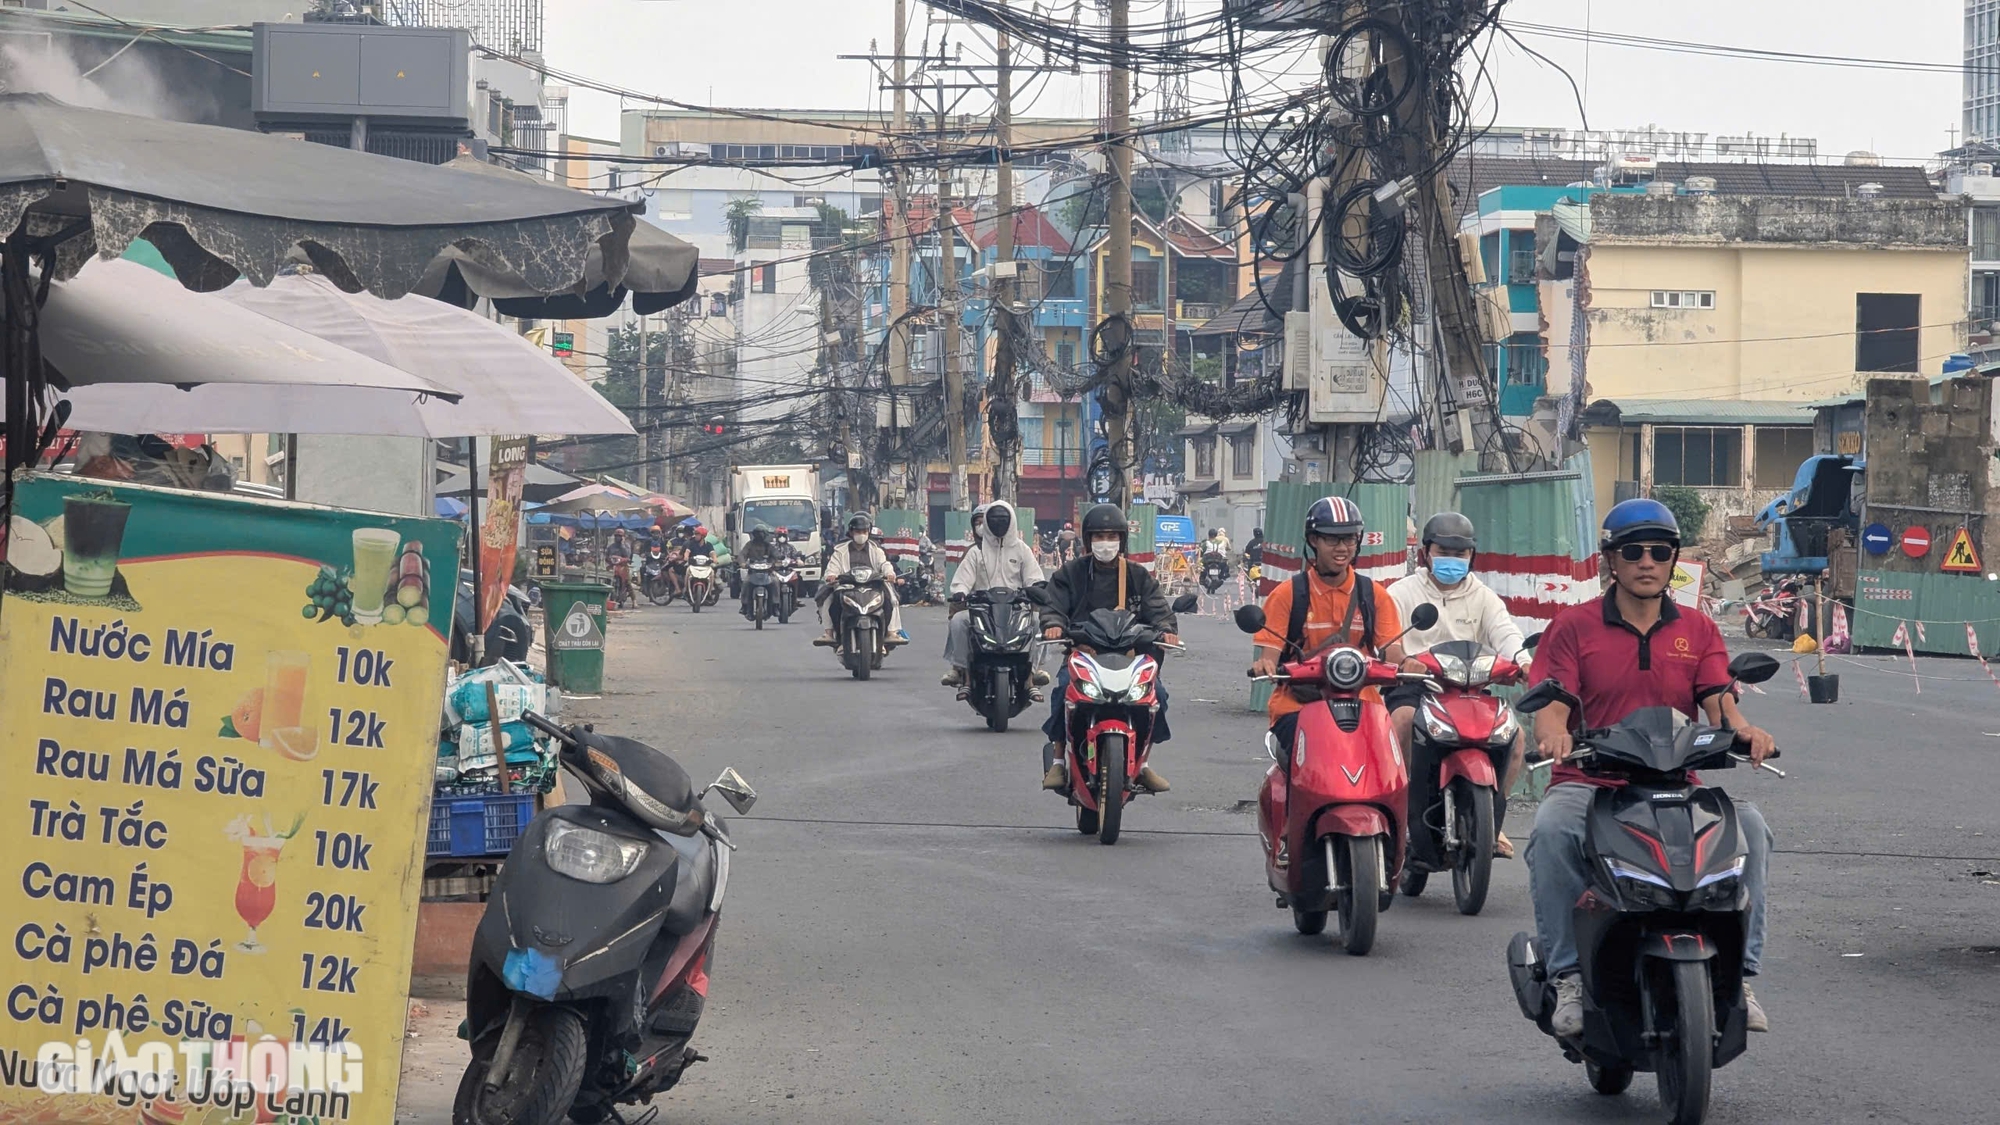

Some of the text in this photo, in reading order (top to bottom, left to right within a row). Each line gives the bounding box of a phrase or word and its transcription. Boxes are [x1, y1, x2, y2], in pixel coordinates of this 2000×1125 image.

[498, 445, 526, 464] LONG
[51, 617, 234, 670] Nước Mía
[337, 646, 393, 688] 10k
[44, 678, 189, 727] Rau Má
[329, 707, 386, 748] 12k
[37, 739, 265, 797] Rau Má Sữa
[322, 769, 379, 809] 17k
[30, 800, 166, 848] Trà Tắc
[315, 829, 372, 871] 10k
[23, 862, 172, 917] Cam Ép
[304, 892, 365, 933] 20k
[15, 923, 225, 978] Cà phê Đá
[302, 953, 359, 993] 12k
[7, 985, 233, 1041] Cà phê Sữa
[293, 1013, 350, 1055] 14k
[92, 1058, 180, 1108] Ngọt
[267, 1076, 349, 1124] Lạnh
